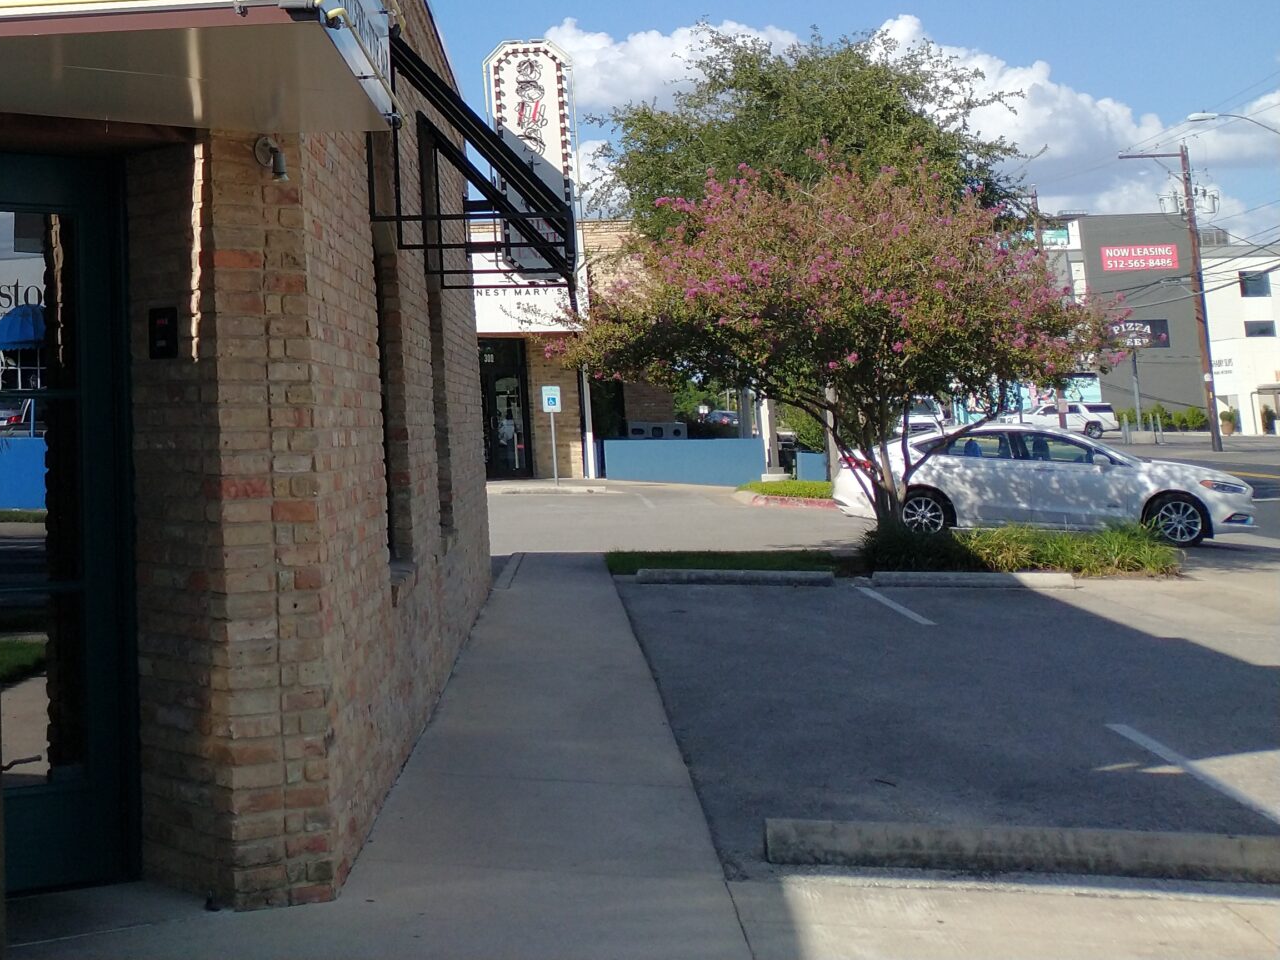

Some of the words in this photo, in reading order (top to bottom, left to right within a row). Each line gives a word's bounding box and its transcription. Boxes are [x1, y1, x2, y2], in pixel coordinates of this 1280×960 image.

[1105, 248, 1129, 257] NOW
[1131, 247, 1173, 256] LEASING
[1112, 322, 1152, 335] PIZZA
